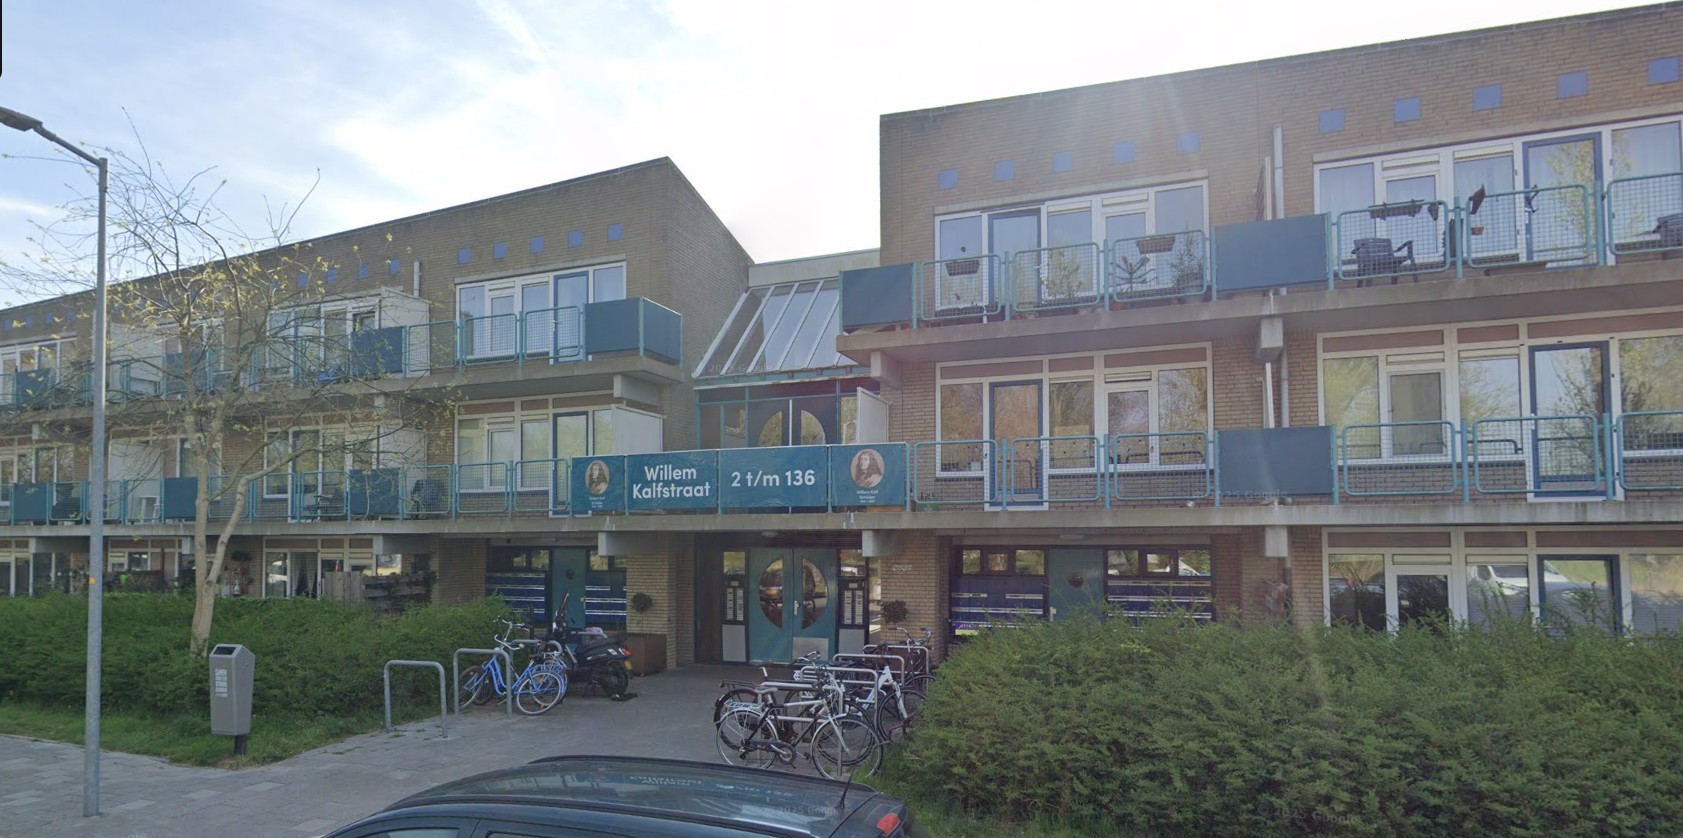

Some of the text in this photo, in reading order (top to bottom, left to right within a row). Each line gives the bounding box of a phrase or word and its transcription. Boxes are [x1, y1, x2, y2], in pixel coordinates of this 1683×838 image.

[643, 463, 697, 481] Willem
[731, 468, 816, 487] 2 t/m 136
[633, 481, 711, 499] Kalfstraat
